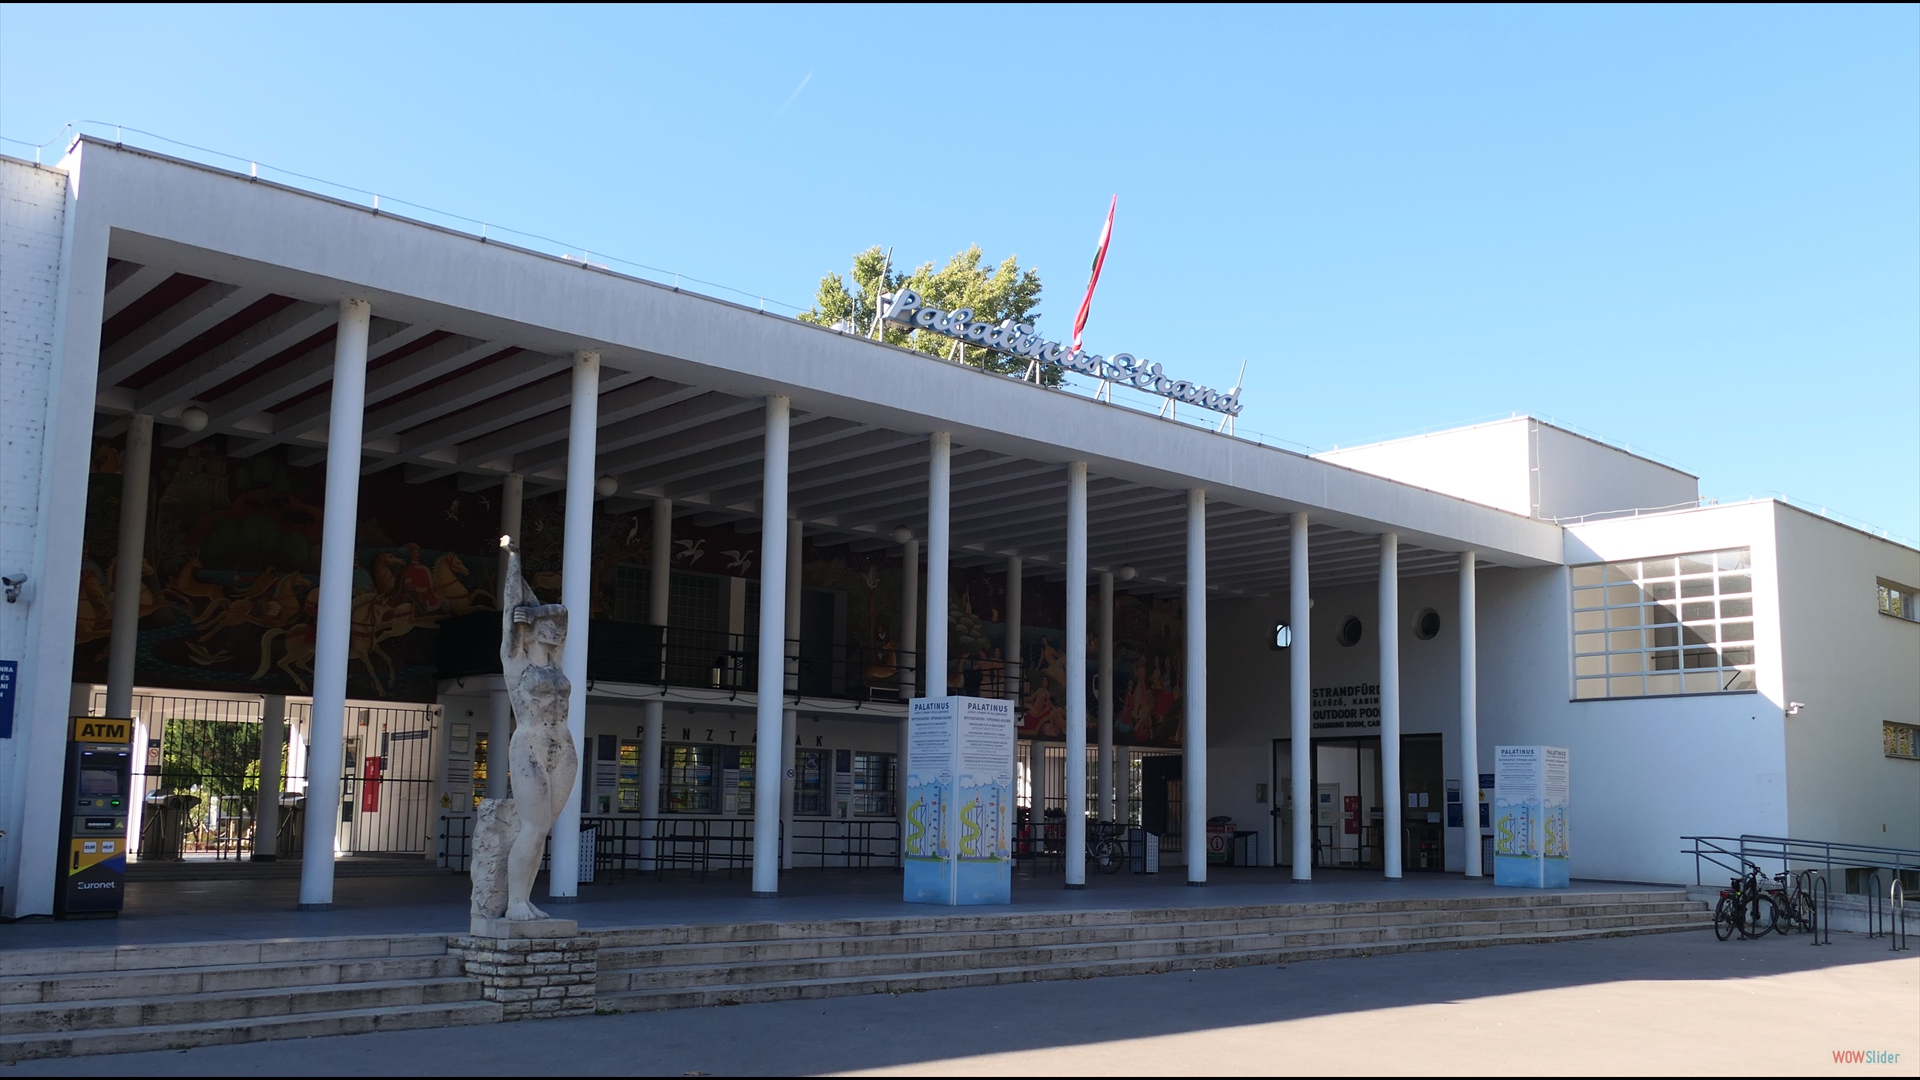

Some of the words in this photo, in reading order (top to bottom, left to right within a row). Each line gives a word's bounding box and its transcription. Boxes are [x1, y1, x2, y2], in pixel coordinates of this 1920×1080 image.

[881, 288, 1102, 377] Palatinus
[1103, 352, 1244, 416] Strand
[914, 702, 950, 711] PALATINUS
[967, 702, 1008, 713] PALATINUS
[1313, 709, 1357, 720] OUTDOOR
[81, 723, 125, 738] ATM
[1313, 721, 1345, 729] CHANGING
[77, 881, 116, 890] Euronet
